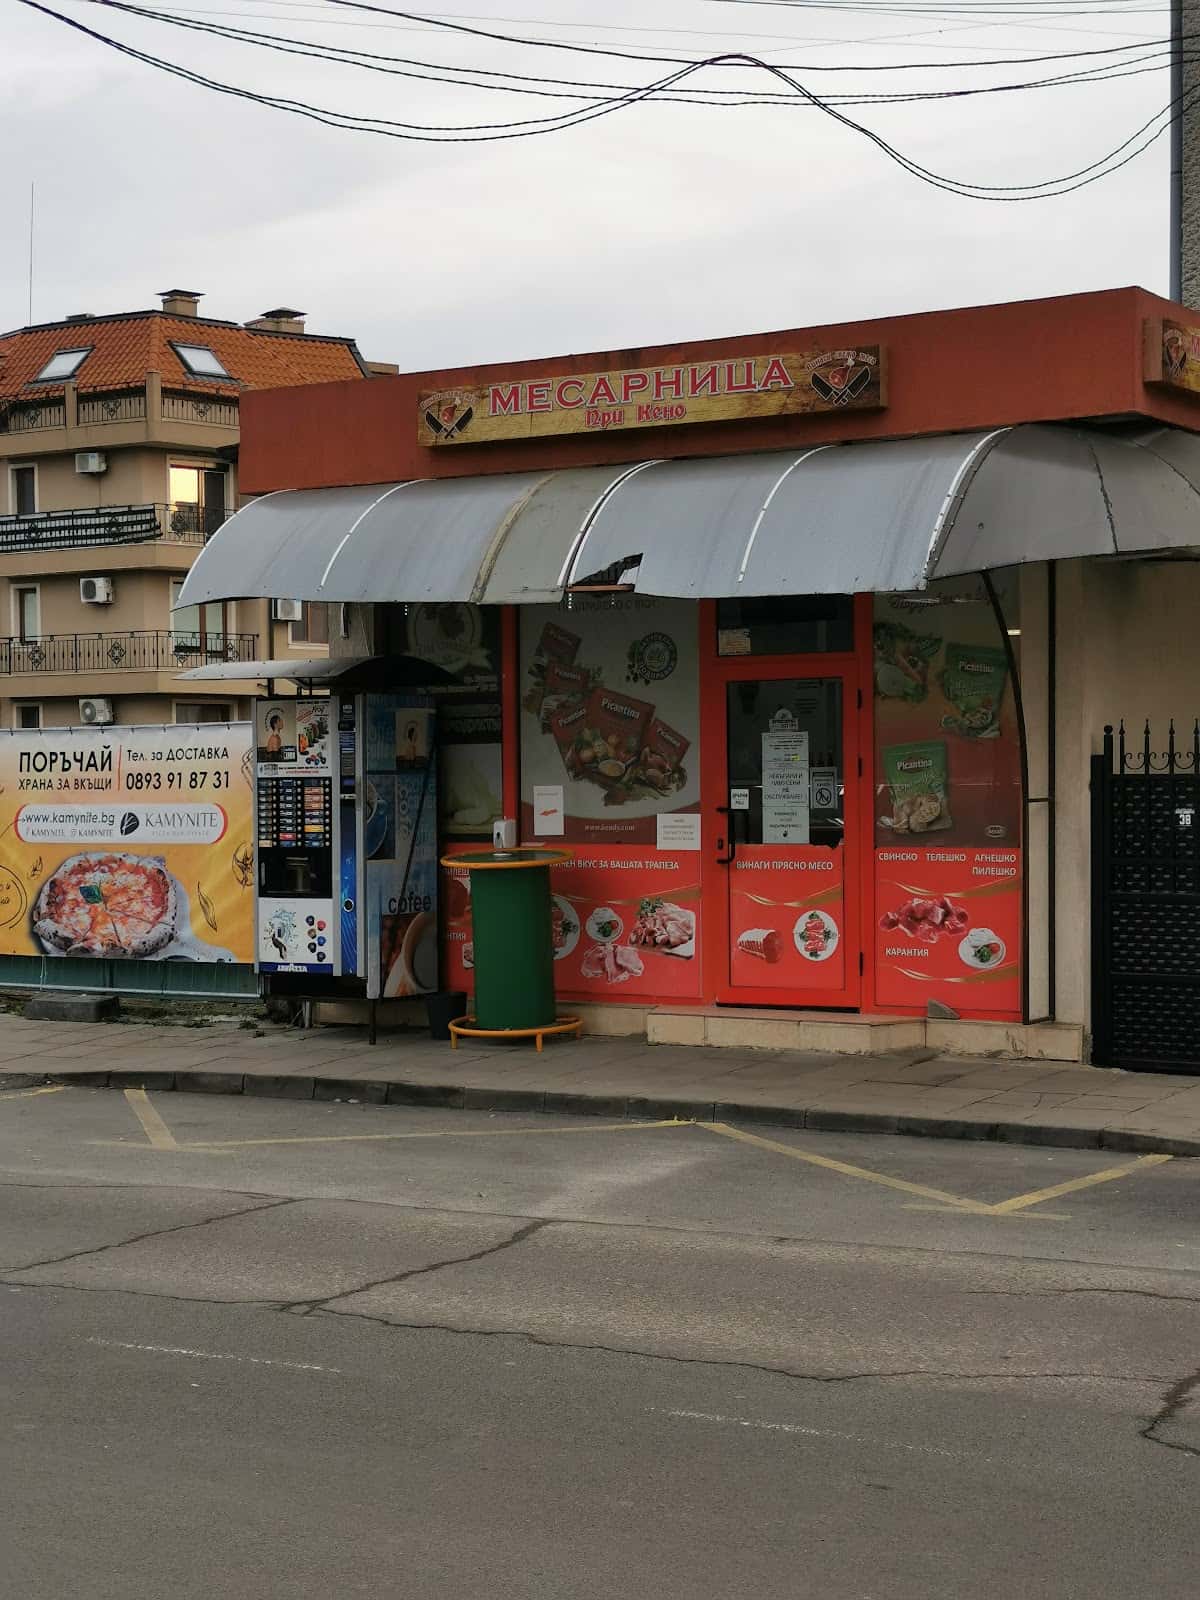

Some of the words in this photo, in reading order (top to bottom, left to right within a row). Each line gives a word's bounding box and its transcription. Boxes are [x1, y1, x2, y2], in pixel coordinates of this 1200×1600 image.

[487, 357, 794, 417] МЕСАРНИЦА
[585, 408, 624, 429] При
[637, 403, 687, 425] Кено
[601, 697, 640, 720] Picantina
[19, 745, 112, 772] ПОРЪЧАЙ
[127, 749, 147, 761] Тел.
[151, 751, 163, 760] за
[166, 747, 229, 762] ДОСТАВКА
[896, 759, 933, 770] Picantina
[18, 778, 53, 790] ХРАНА
[57, 778, 70, 790] ЗА
[74, 777, 112, 791] ВКЪЩИ
[126, 772, 162, 790] 0893
[167, 772, 182, 789] 91
[189, 771, 208, 789] 87
[213, 770, 229, 789] 31
[25, 811, 115, 826] www.kamynite.bg
[145, 812, 218, 828] KAMYNITE
[577, 859, 598, 869] ВКУС
[599, 860, 609, 869] ЗА
[610, 860, 643, 870] ВАШАТА
[645, 860, 680, 870] ТРАПЕЗА
[878, 852, 918, 862] СВИНСКО
[926, 853, 966, 862] ТЕЛЕШКО
[974, 853, 1016, 863] АГНЕШКО
[736, 860, 771, 870] ВИНАГИ
[772, 860, 807, 871] ПРЯСНО
[808, 861, 834, 871] МЕСО
[972, 866, 1016, 876] ПИЛЕШКО
[388, 891, 432, 913] cofee
[885, 948, 929, 958] КАРАНТИЯ
